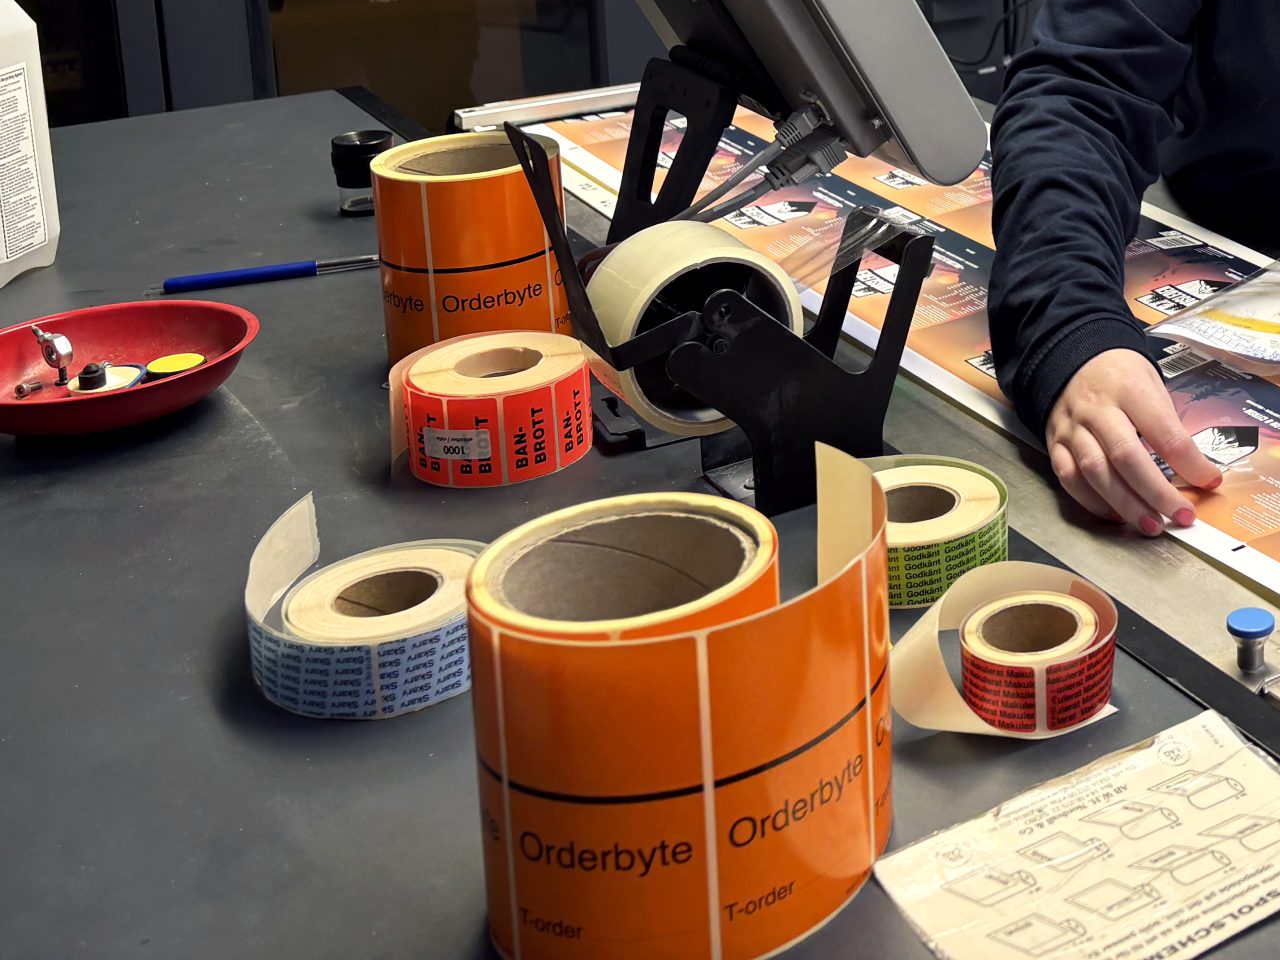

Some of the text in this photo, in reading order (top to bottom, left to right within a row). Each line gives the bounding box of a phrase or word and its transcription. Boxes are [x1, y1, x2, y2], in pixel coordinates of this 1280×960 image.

[442, 283, 543, 314] Orderbyte
[573, 389, 584, 446] BROTT
[530, 407, 547, 464] BROTT
[563, 410, 574, 453] BAN-
[443, 445, 466, 455] 1000
[513, 427, 529, 469] BAN-
[944, 536, 976, 554] Godkänt
[904, 550, 941, 562] Godkänt
[945, 546, 976, 563] Godkänt
[905, 559, 941, 571] Godkänt
[946, 555, 977, 572] Godkänt
[905, 569, 942, 580] Godkänt
[906, 578, 942, 589] Godkänt
[907, 587, 943, 599] Godkänt
[412, 635, 441, 650] Skarv
[441, 633, 467, 649] Skarv
[407, 648, 436, 662] Skarv
[440, 645, 466, 659] Skarv
[405, 660, 434, 674] Skarv
[438, 657, 465, 673] Skarv
[403, 668, 463, 685] Skarv Skarv
[402, 680, 462, 697] Skarv Skarv
[400, 695, 430, 709] Skarv
[728, 753, 864, 849] Orderbyte
[519, 831, 694, 878] Orderbyte
[723, 878, 796, 922] T-order
[519, 907, 583, 941] T-order
